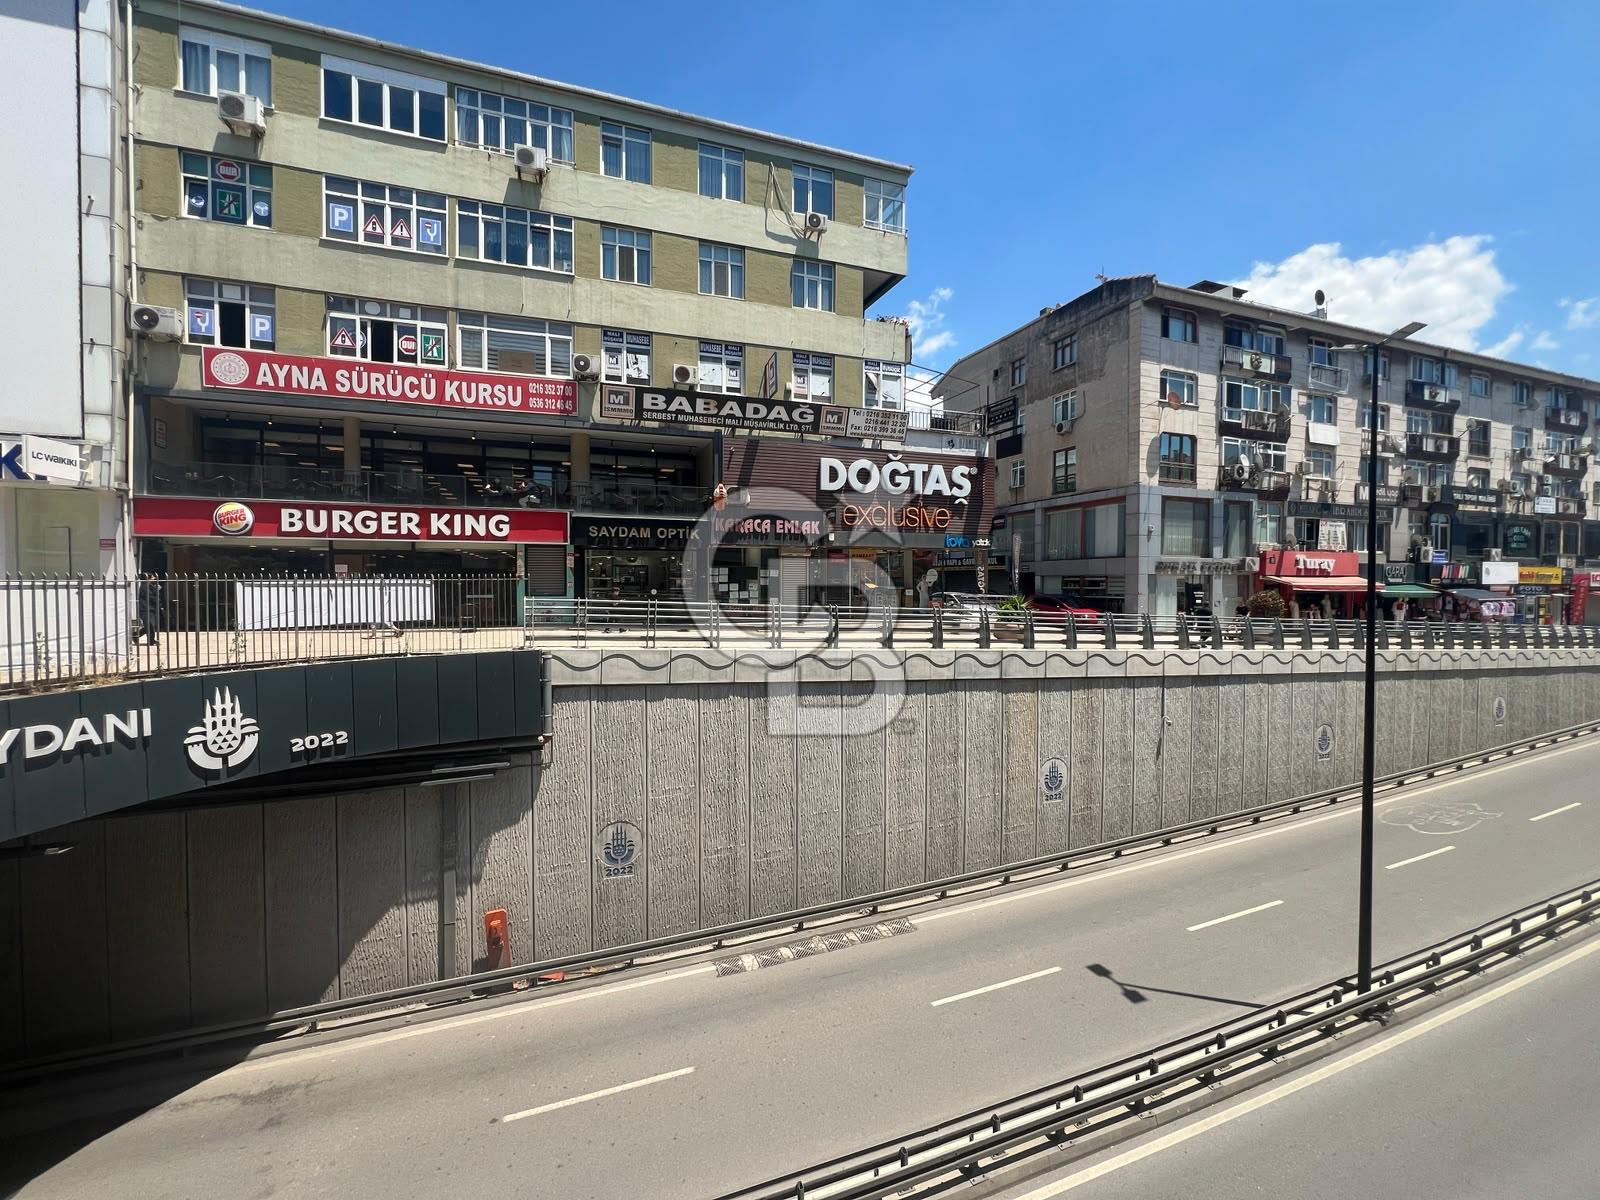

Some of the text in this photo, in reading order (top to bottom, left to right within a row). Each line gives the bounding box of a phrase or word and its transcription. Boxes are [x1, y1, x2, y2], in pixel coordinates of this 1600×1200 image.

[256, 362, 523, 407] AYNA SÜRÜCÜ KURSU
[528, 382, 543, 394] 0216
[544, 384, 556, 395] 352
[556, 385, 564, 395] 37
[528, 397, 543, 408] 0536
[544, 398, 556, 410] 312
[642, 392, 815, 423] BABADAĞ
[642, 411, 675, 421] SERBEST
[677, 414, 724, 425] MUHASEBECİ
[725, 418, 742, 426] MALİ
[743, 420, 785, 430] MÜŞAVİRLİK
[31, 451, 43, 460] LC
[820, 453, 972, 504] DOĞTAŞ
[217, 508, 245, 519] BURGER
[220, 513, 247, 526] KING
[843, 500, 951, 528] exclusive
[281, 507, 511, 537] BURGER KING
[715, 518, 820, 535] KARACA EMLAK
[588, 526, 700, 539] SAYDAM OPTİK
[290, 730, 349, 752] 2022
[1044, 793, 1062, 801] 2022
[605, 866, 633, 877] 2022
